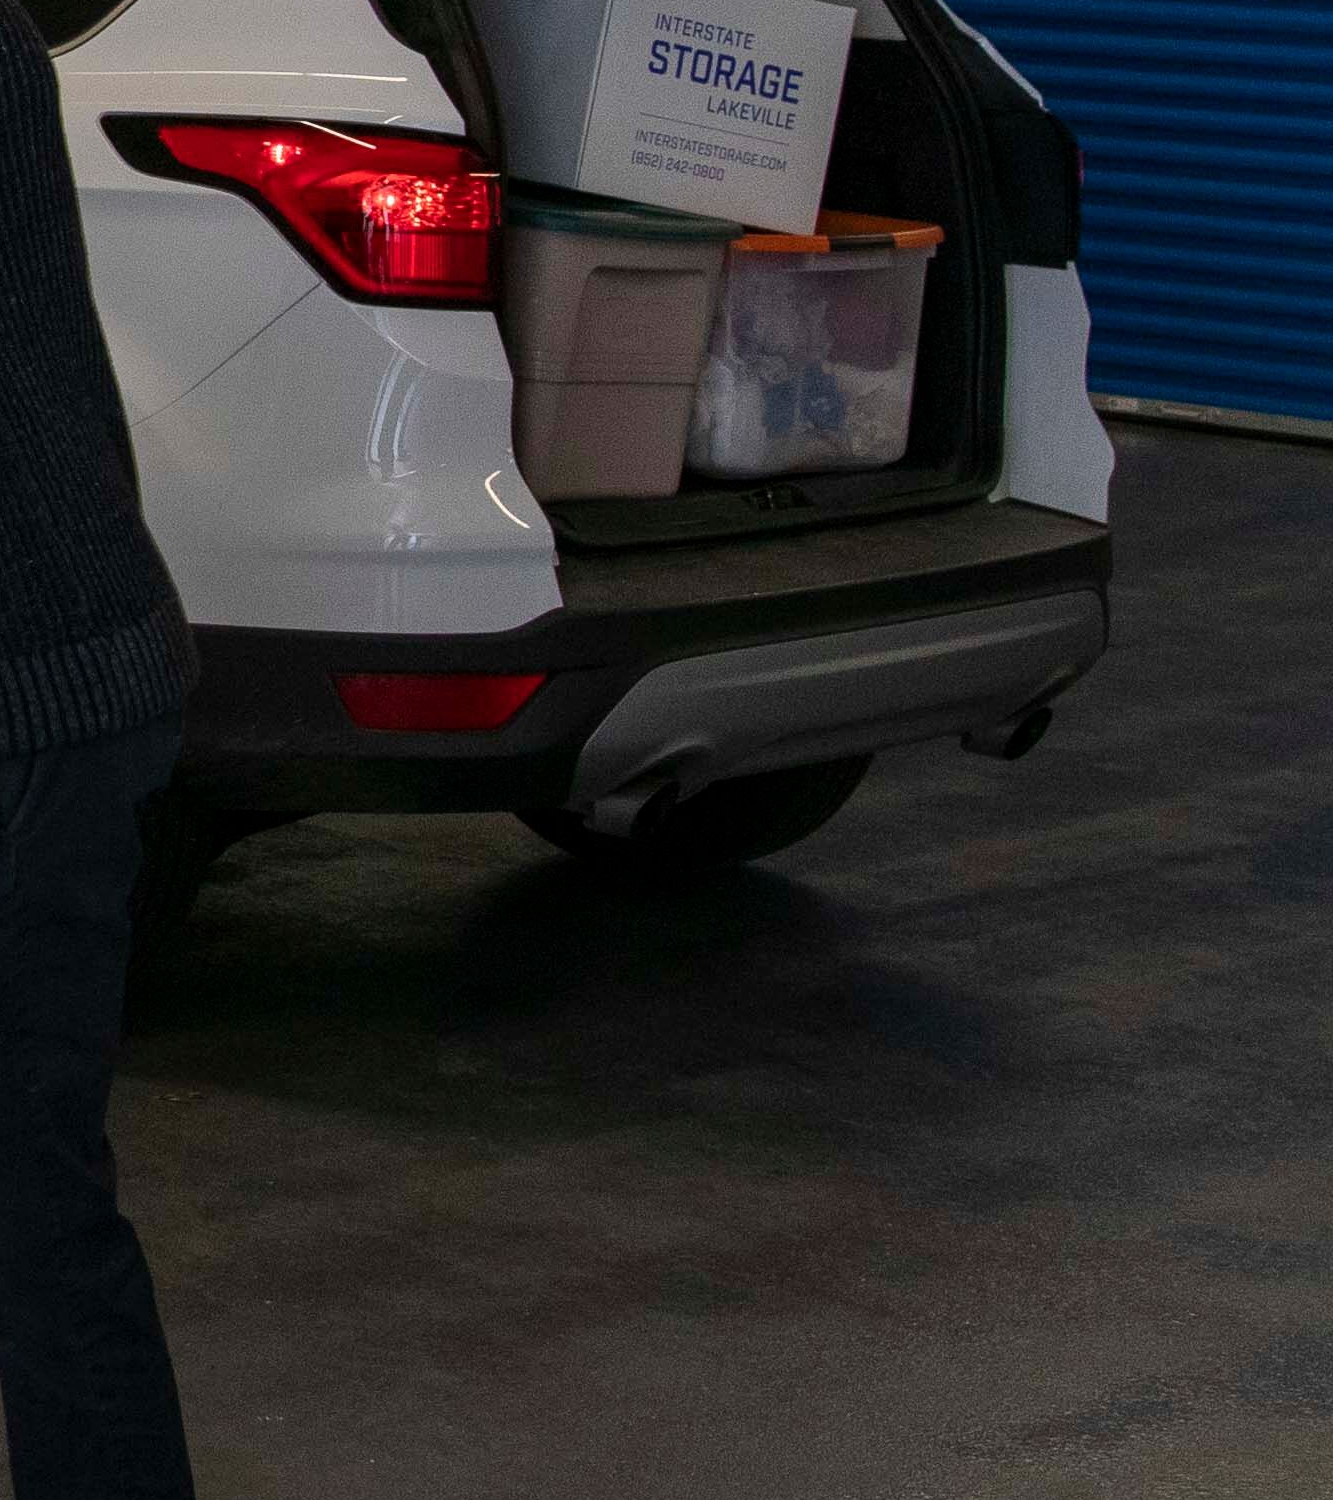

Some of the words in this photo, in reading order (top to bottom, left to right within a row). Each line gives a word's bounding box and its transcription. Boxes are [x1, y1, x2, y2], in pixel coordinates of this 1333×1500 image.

[655, 13, 755, 50] INTERSTATE
[648, 40, 804, 105] STORAGE
[707, 96, 796, 131] LAKEVILLE
[631, 149, 663, 170] (952)
[665, 154, 725, 182] 242-0800
[636, 130, 788, 172] INTERSTATESTORAGE.COM
